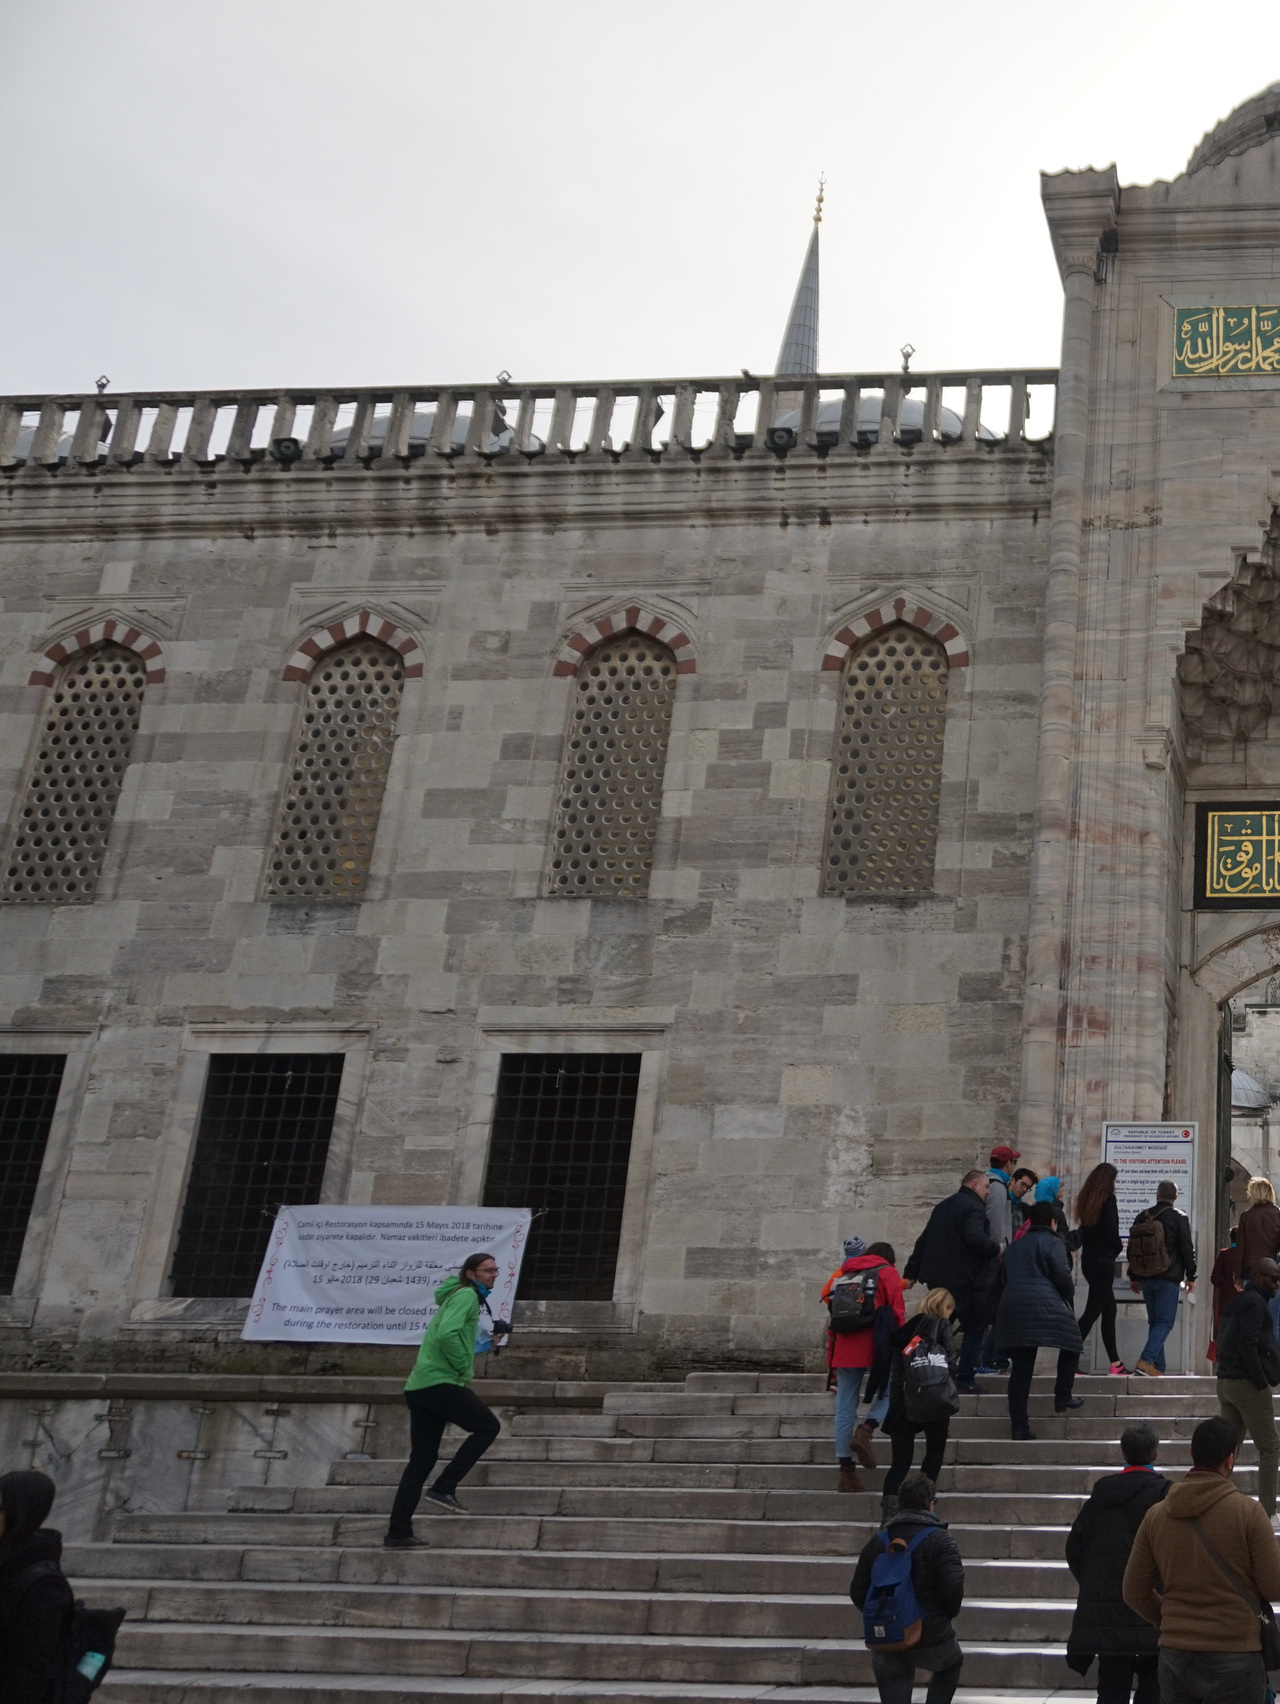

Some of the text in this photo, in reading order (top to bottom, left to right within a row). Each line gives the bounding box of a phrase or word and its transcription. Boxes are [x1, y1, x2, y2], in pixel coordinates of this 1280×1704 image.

[325, 1221, 367, 1229] Restorasyon
[451, 1222, 471, 1230] 2018
[473, 1222, 503, 1231] tarihine
[272, 1303, 287, 1311] The
[290, 1305, 312, 1313] main
[315, 1306, 343, 1316] prayer
[367, 1306, 382, 1314] will
[385, 1306, 395, 1315] be
[398, 1306, 427, 1315] closed
[284, 1318, 314, 1329] during
[316, 1320, 332, 1328] the
[334, 1320, 384, 1330] restoration
[386, 1321, 406, 1330] until
[409, 1322, 420, 1330] 15
